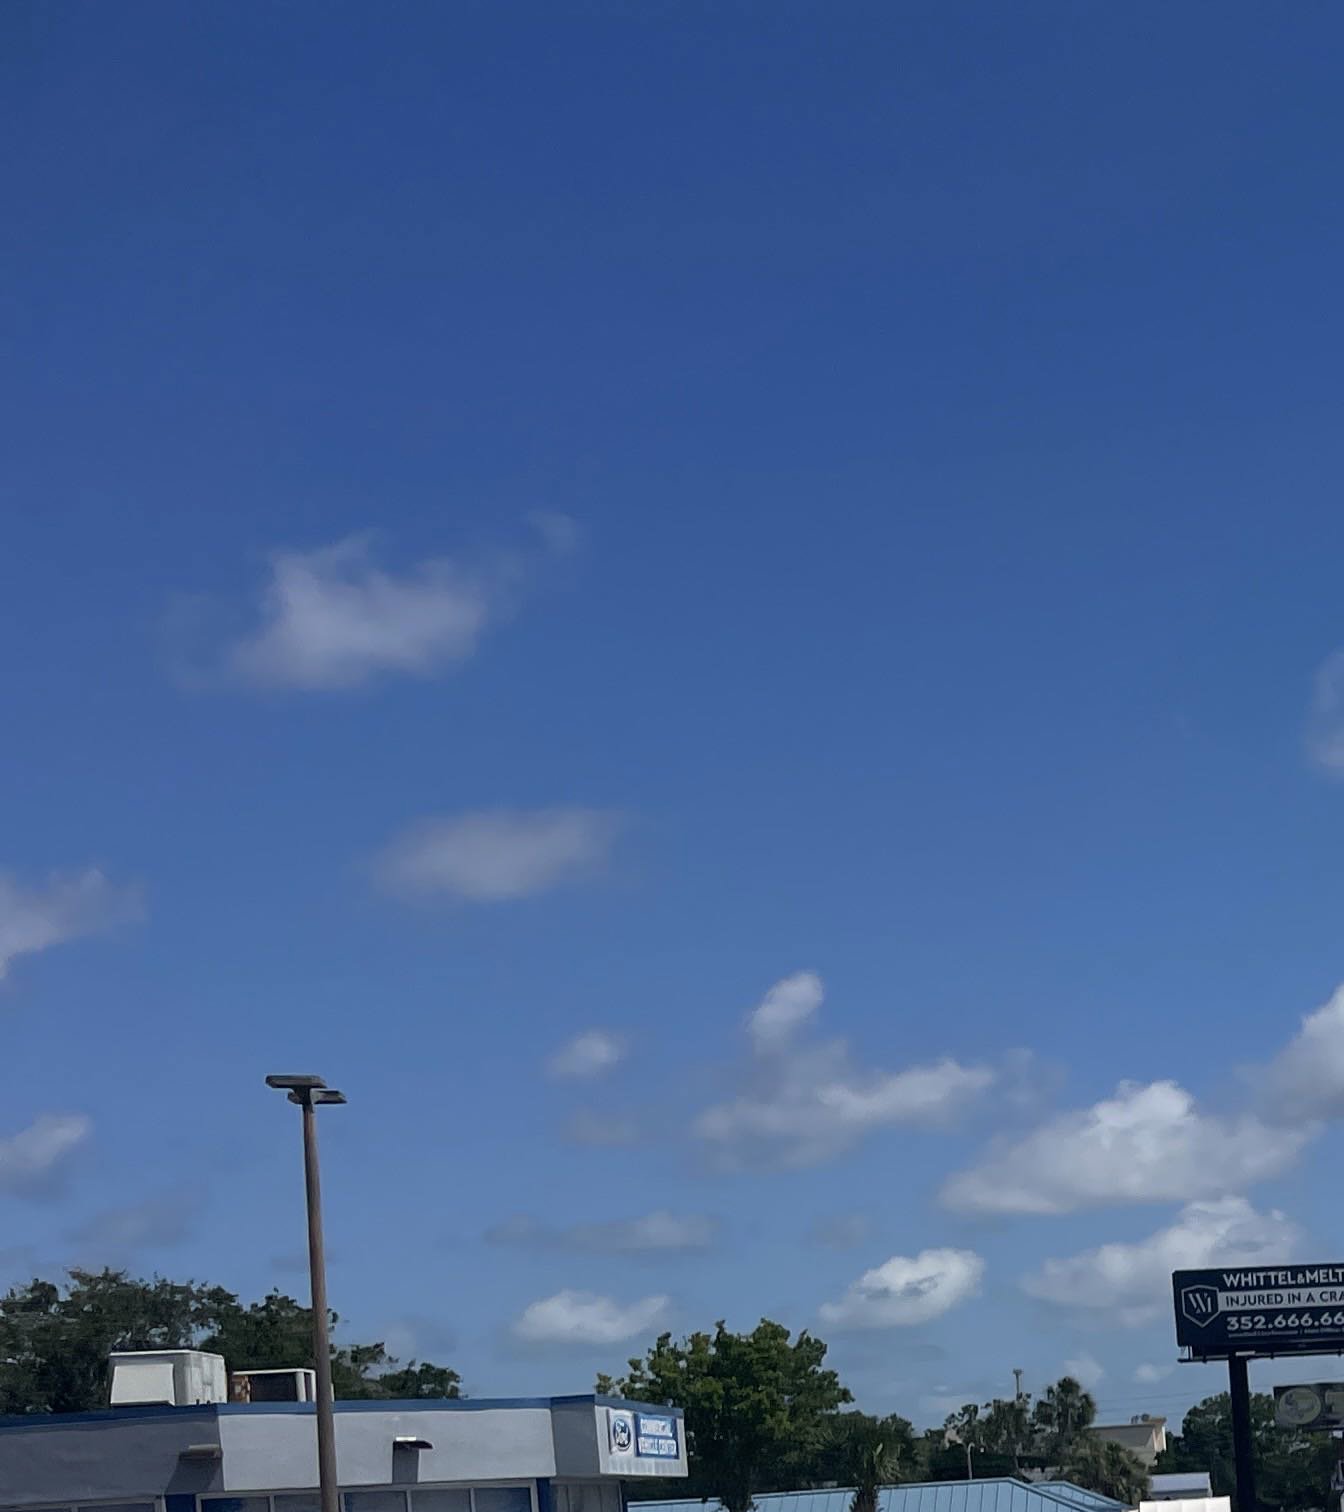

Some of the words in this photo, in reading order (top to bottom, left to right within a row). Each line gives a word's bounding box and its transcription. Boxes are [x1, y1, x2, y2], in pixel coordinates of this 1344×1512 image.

[1225, 1292, 1284, 1307] INJURED
[1287, 1291, 1301, 1305] IN
[1305, 1291, 1316, 1303] A
